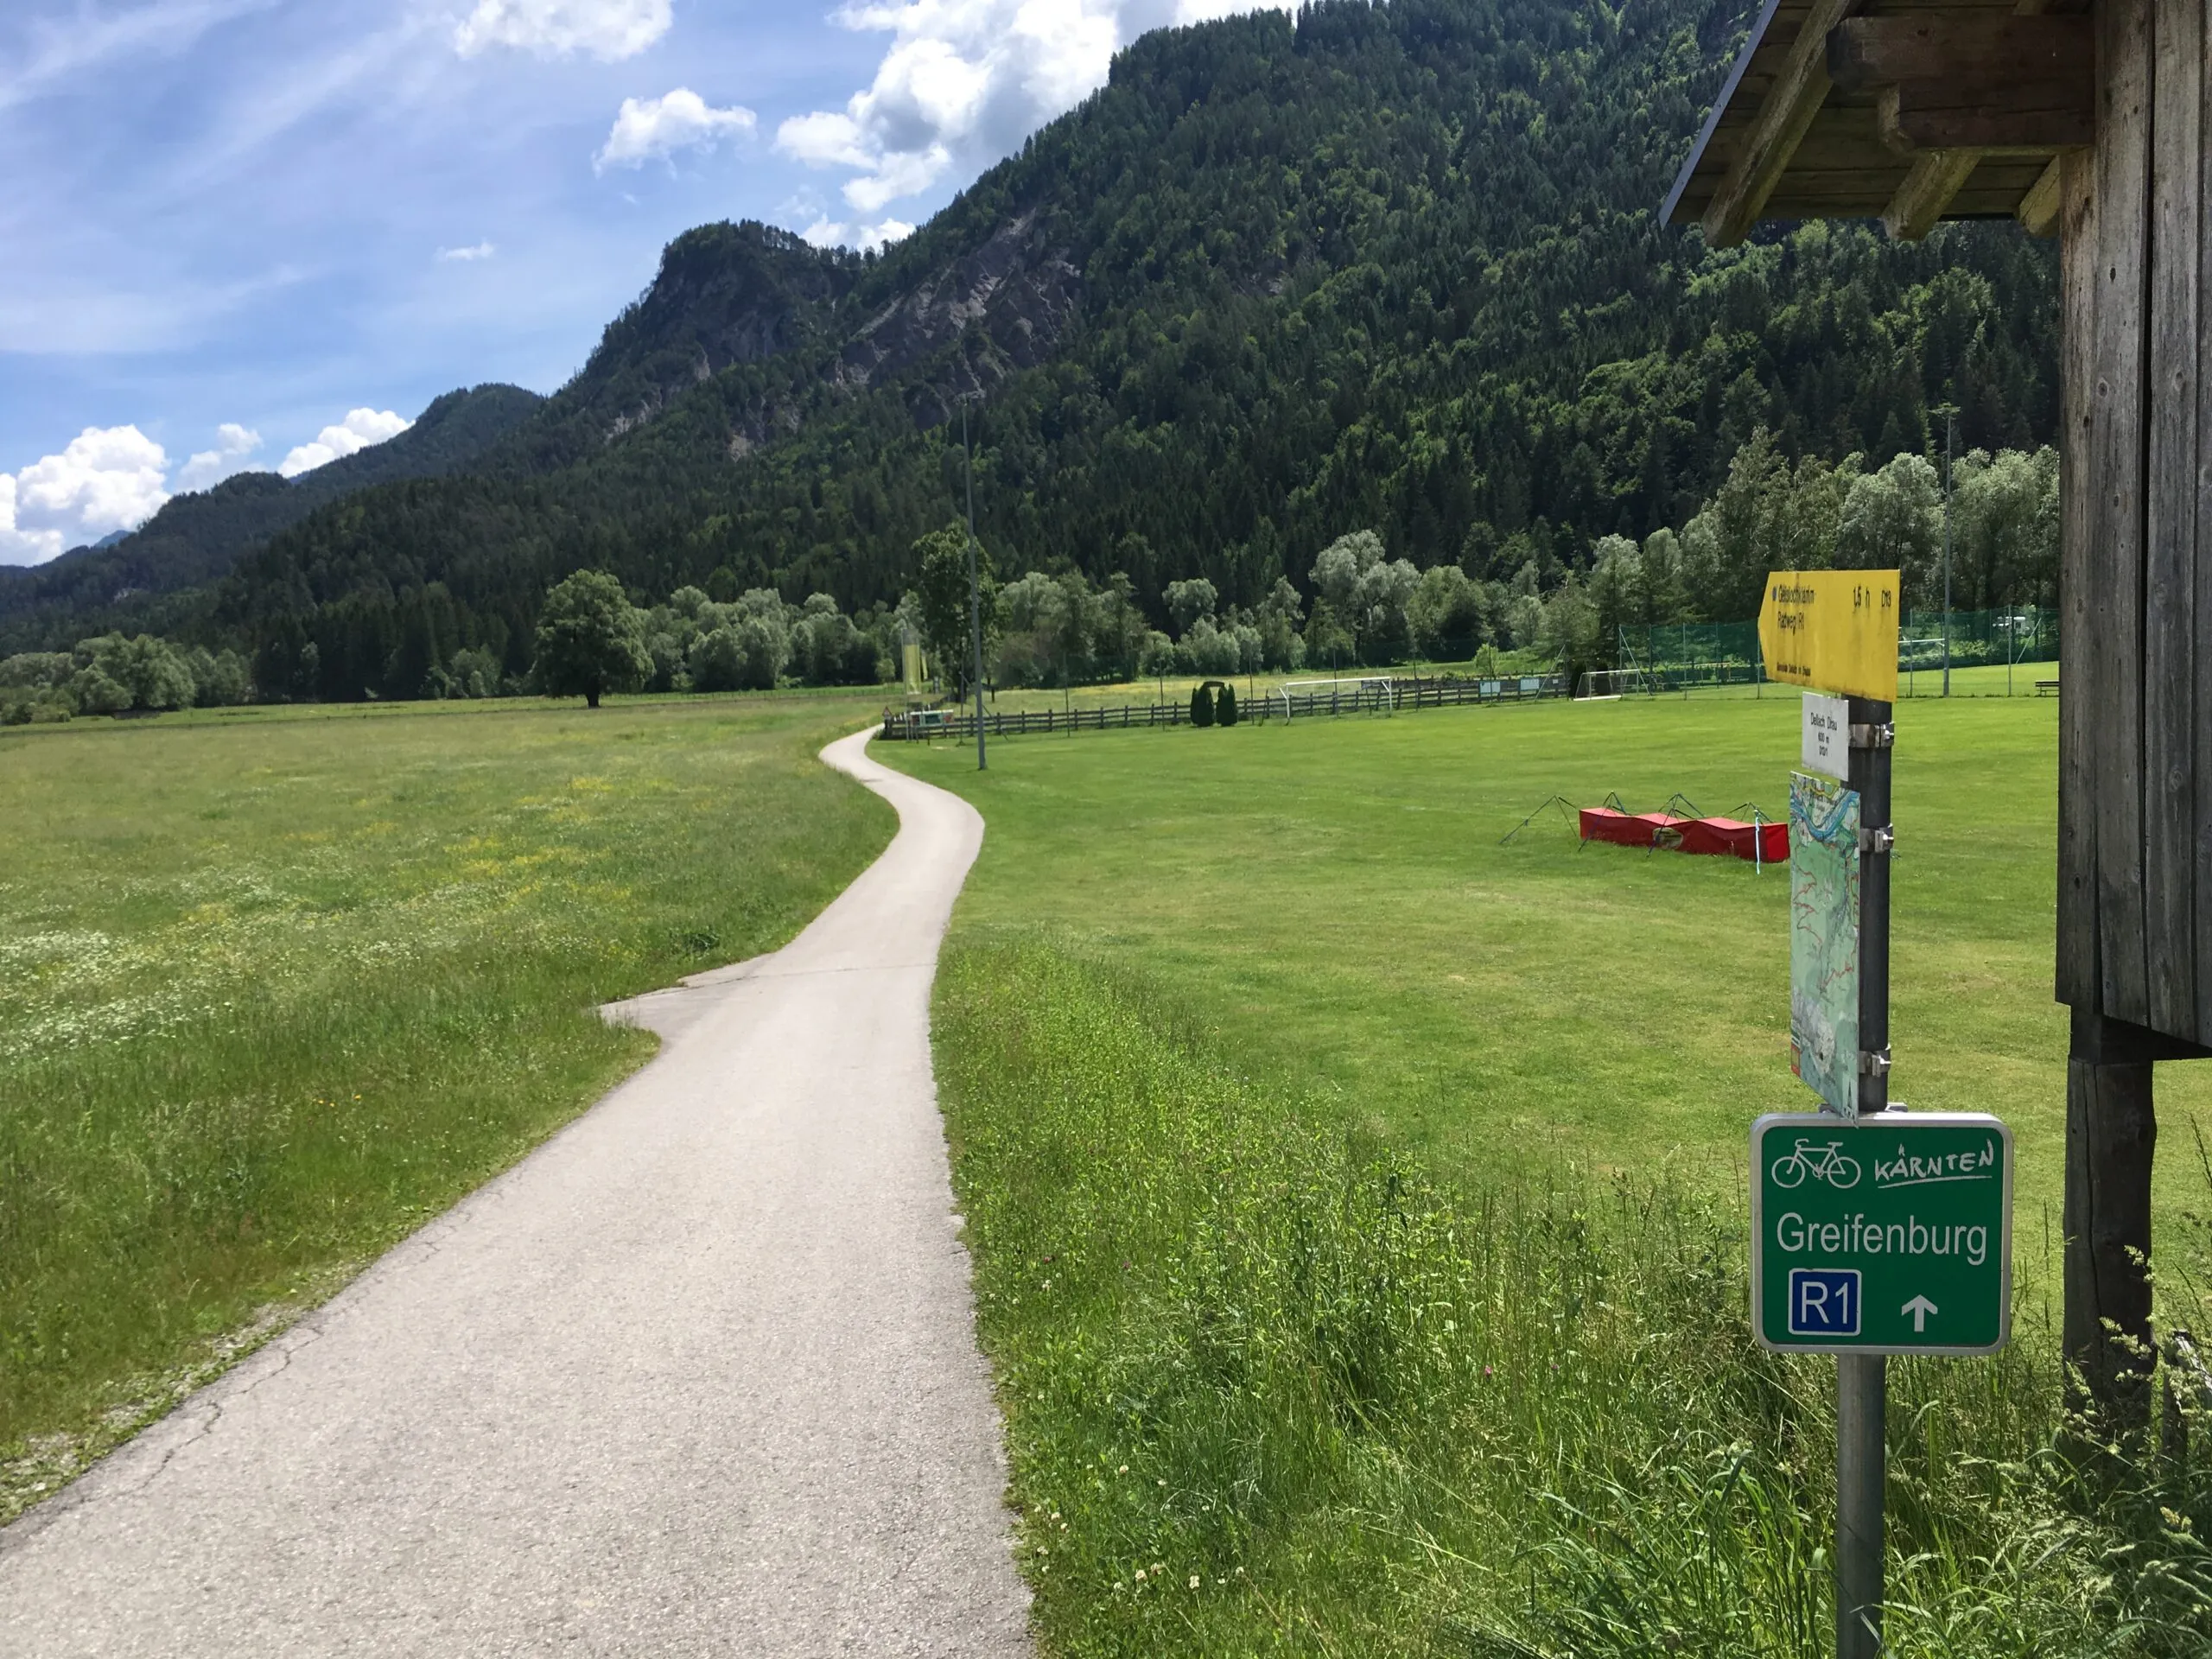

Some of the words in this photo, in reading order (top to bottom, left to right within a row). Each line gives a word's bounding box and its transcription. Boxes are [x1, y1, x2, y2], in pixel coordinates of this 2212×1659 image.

[1866, 587, 1871, 608] h
[1777, 611, 1796, 636] Radweg
[1810, 712, 1826, 728] Dellach
[1827, 715, 1838, 731] Drau
[1874, 1139, 1993, 1182] KÄRNTEN
[1777, 1211, 1987, 1266] Greifenburg
[1801, 1281, 1848, 1325] R1
